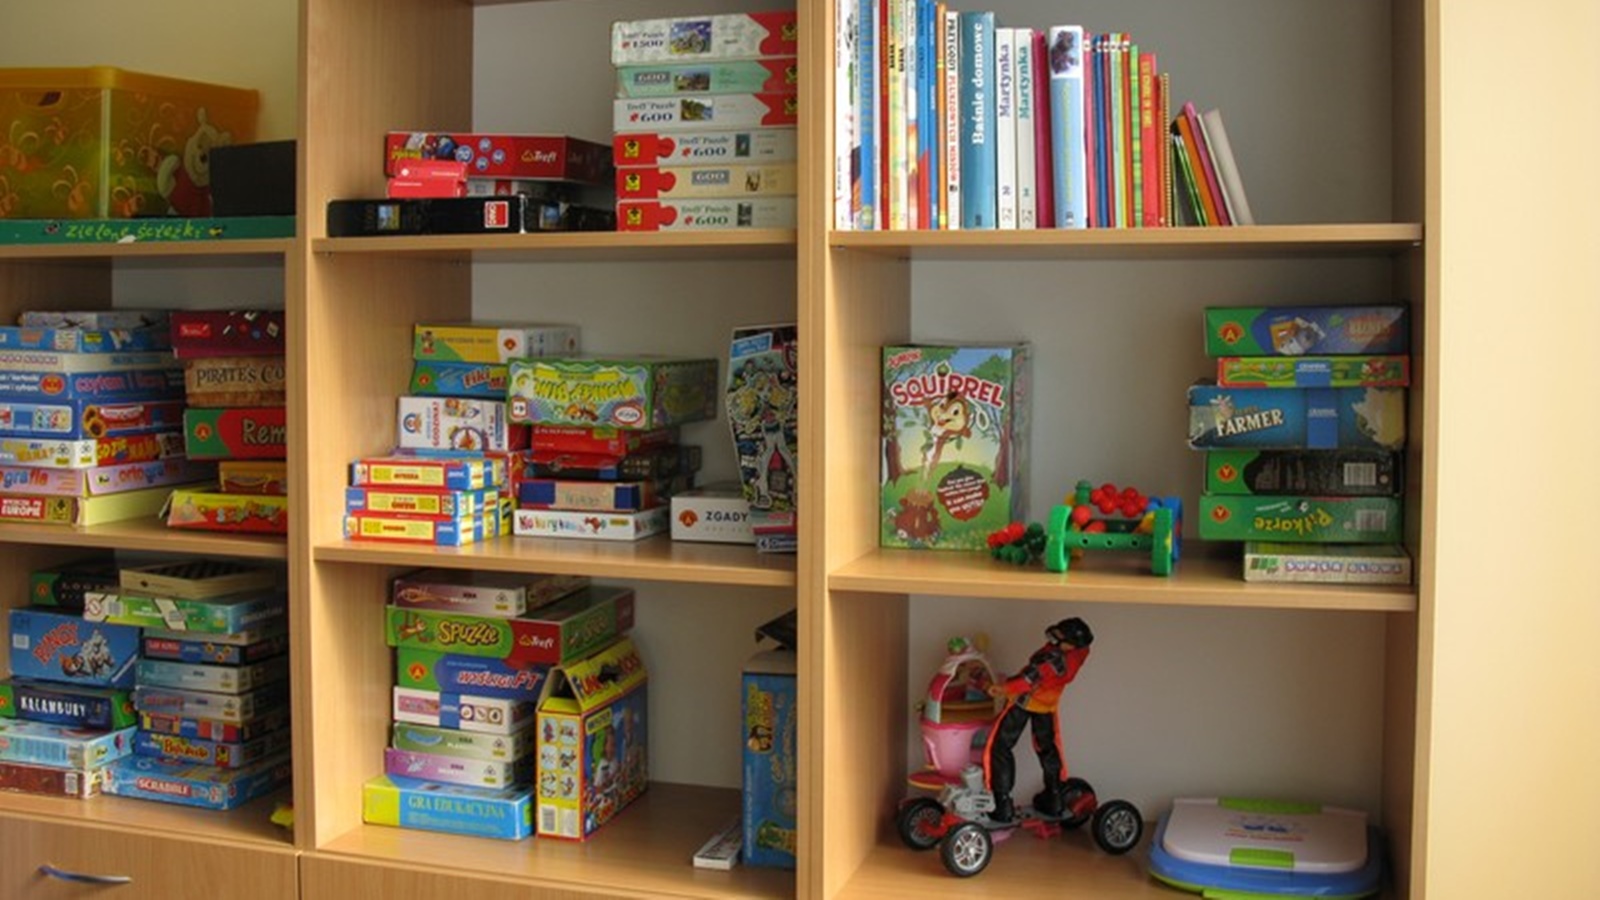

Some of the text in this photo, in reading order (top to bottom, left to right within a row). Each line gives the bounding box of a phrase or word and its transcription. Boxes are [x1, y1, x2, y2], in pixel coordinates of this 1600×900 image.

[632, 40, 664, 49] 1500
[948, 18, 956, 71] PRZYGODY
[637, 73, 667, 81] 600
[971, 22, 985, 145] Baśnie domowe
[999, 44, 1012, 118] Martynka
[1019, 46, 1030, 119] Martynka
[640, 113, 673, 122] 600
[693, 148, 727, 156] 600
[696, 172, 725, 181] 600
[695, 216, 729, 225] 600
[197, 365, 257, 388] PIRATE'S
[463, 366, 490, 388] Fiki
[1216, 408, 1284, 437] FARMER
[705, 511, 749, 522] ZGADY
[531, 635, 554, 649] Trefl
[513, 671, 541, 691] F1
[21, 696, 86, 717] KALAMBURY
[138, 778, 190, 796] SCRABBLE
[408, 795, 505, 819] GRA EDUKACYJNA
